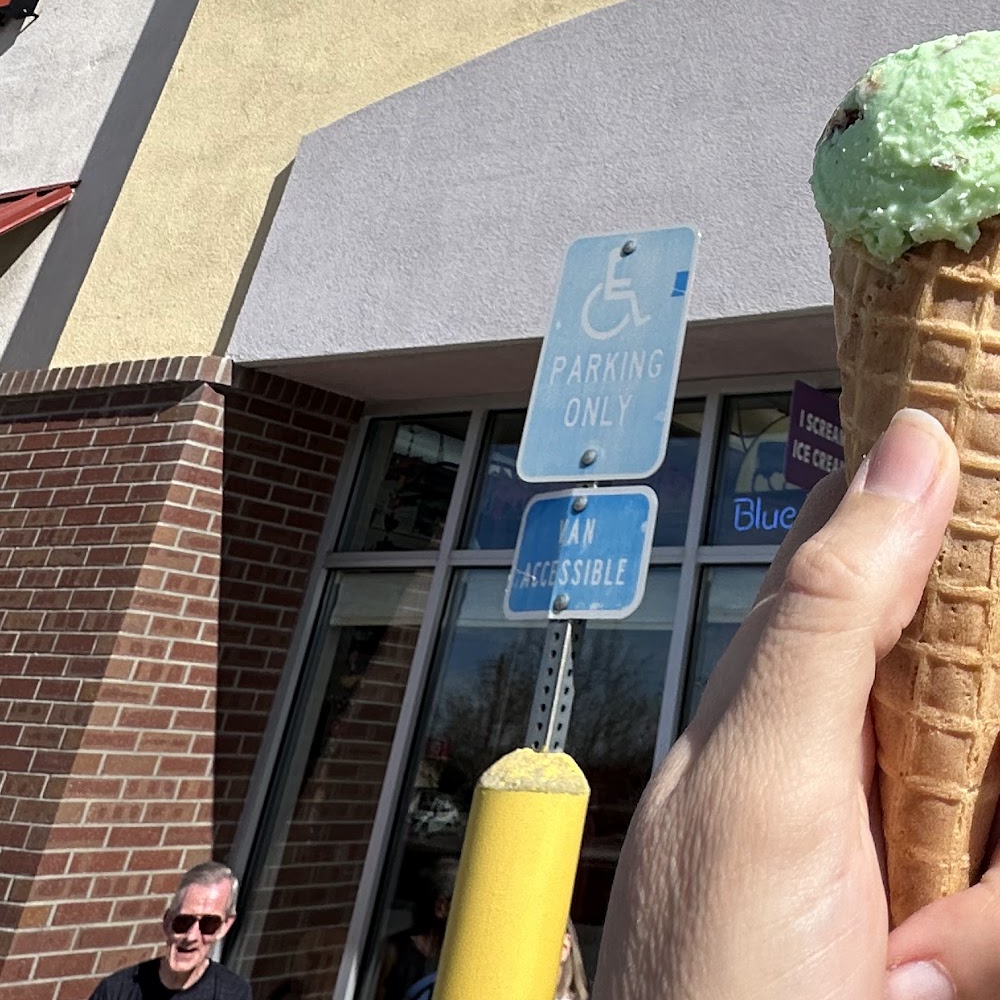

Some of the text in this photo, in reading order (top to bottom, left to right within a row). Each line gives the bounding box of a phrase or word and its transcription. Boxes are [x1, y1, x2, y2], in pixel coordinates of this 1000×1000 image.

[549, 348, 665, 386] PARKING
[563, 393, 634, 428] ONLY
[798, 408, 806, 428] I
[792, 438, 811, 464] ICE
[733, 496, 797, 532] Blue
[558, 517, 597, 548] VAN
[519, 557, 628, 590] ACCESSIBLE
